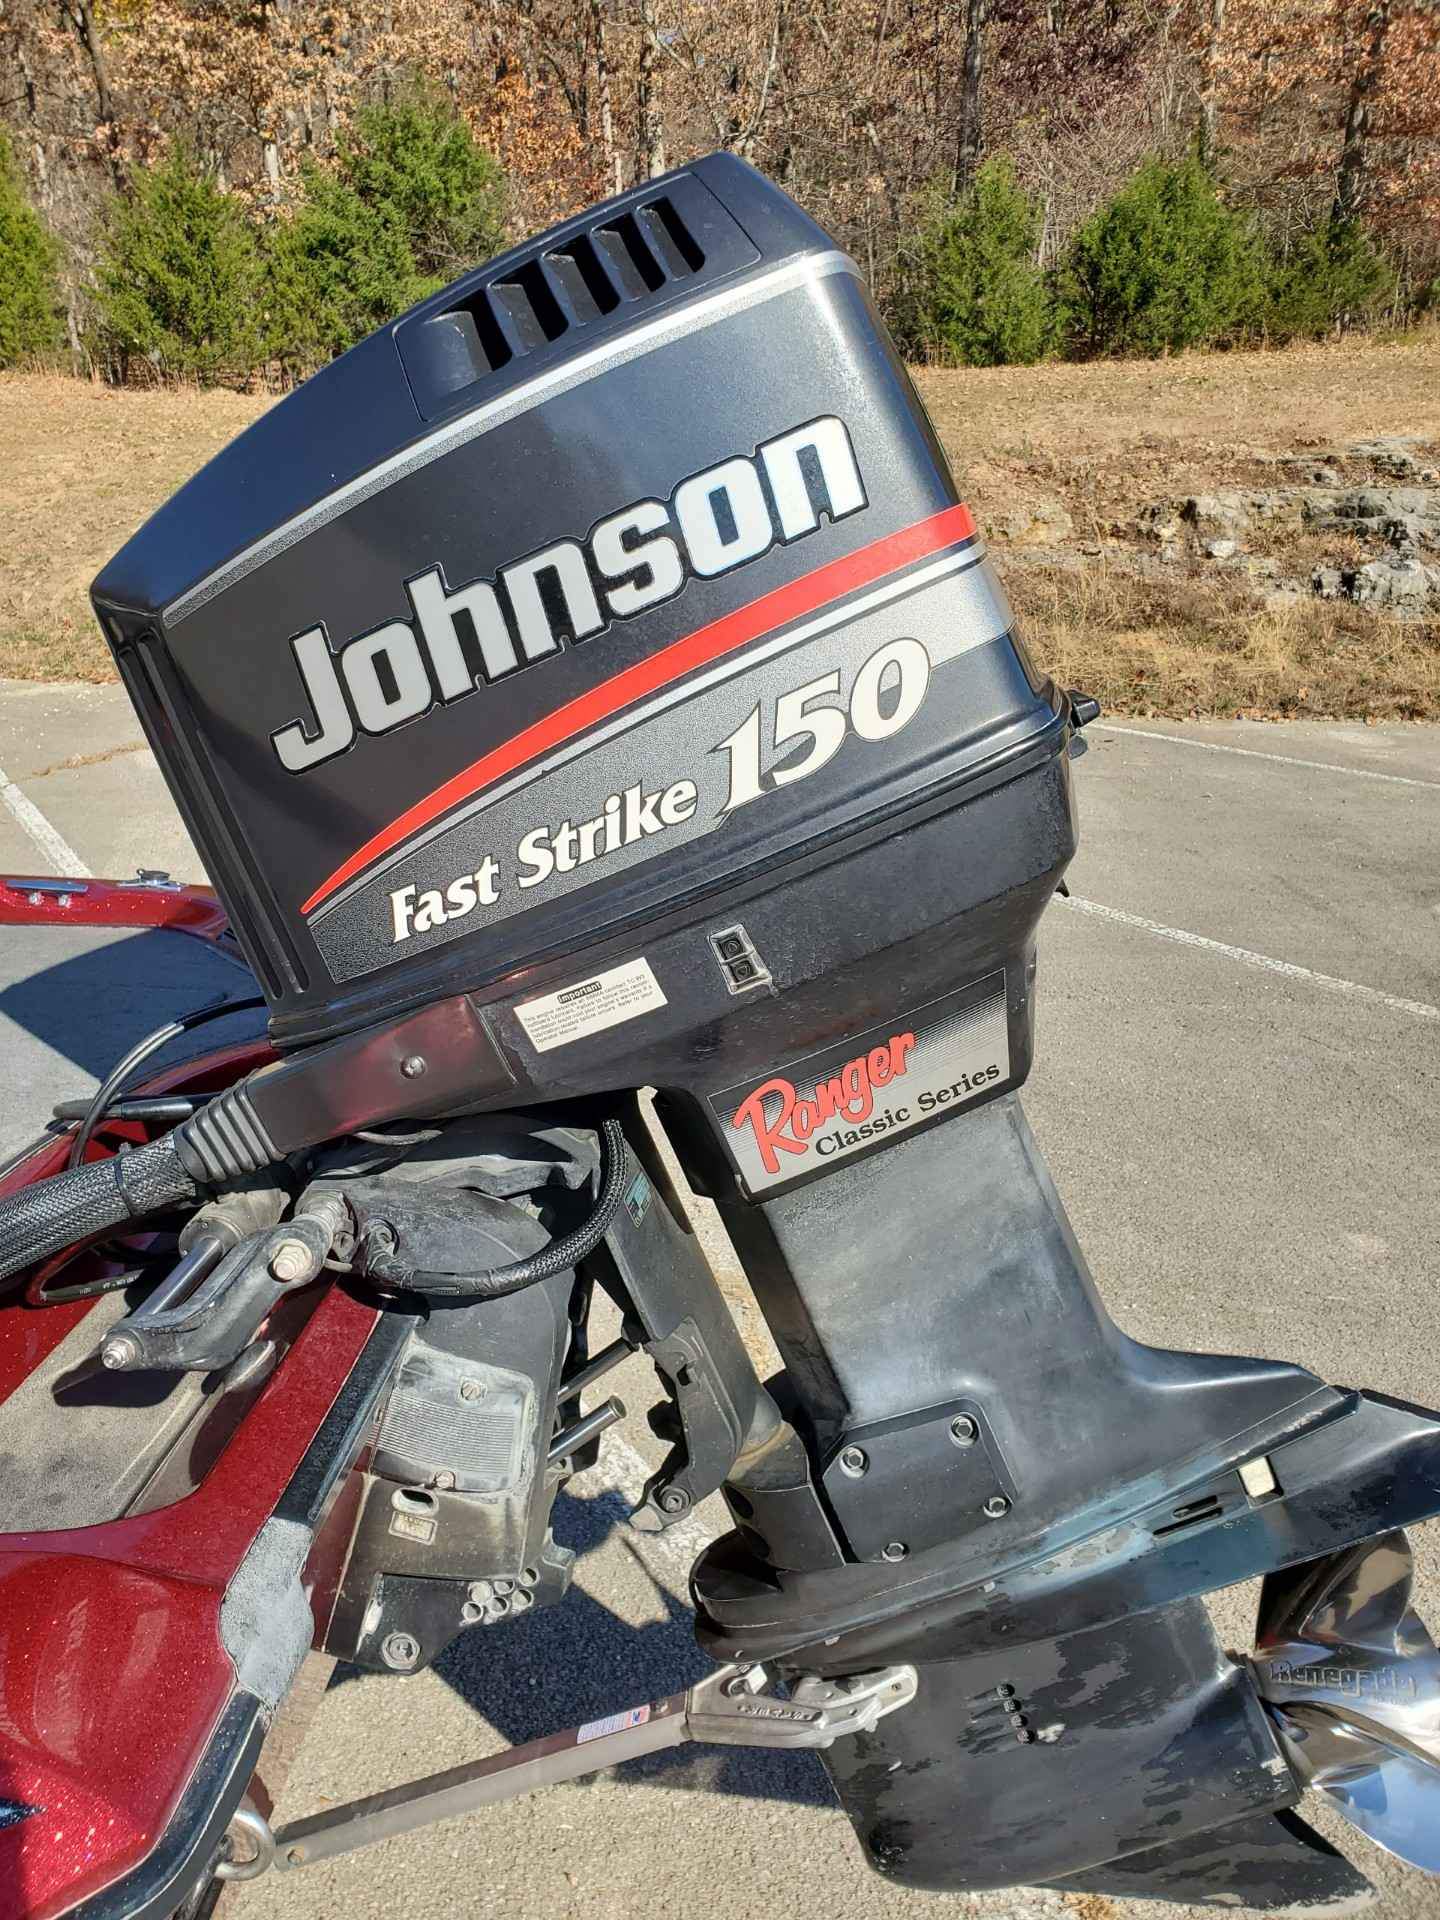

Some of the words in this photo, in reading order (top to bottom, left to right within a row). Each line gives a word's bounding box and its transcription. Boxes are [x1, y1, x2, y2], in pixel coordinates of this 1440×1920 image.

[271, 416, 868, 774] Johnson
[388, 856, 500, 944] Fast
[517, 778, 698, 888] Strike
[706, 637, 932, 820] 150
[732, 1031, 916, 1174] Ranger
[815, 1105, 911, 1156] Classic
[917, 1063, 1001, 1113] Series
